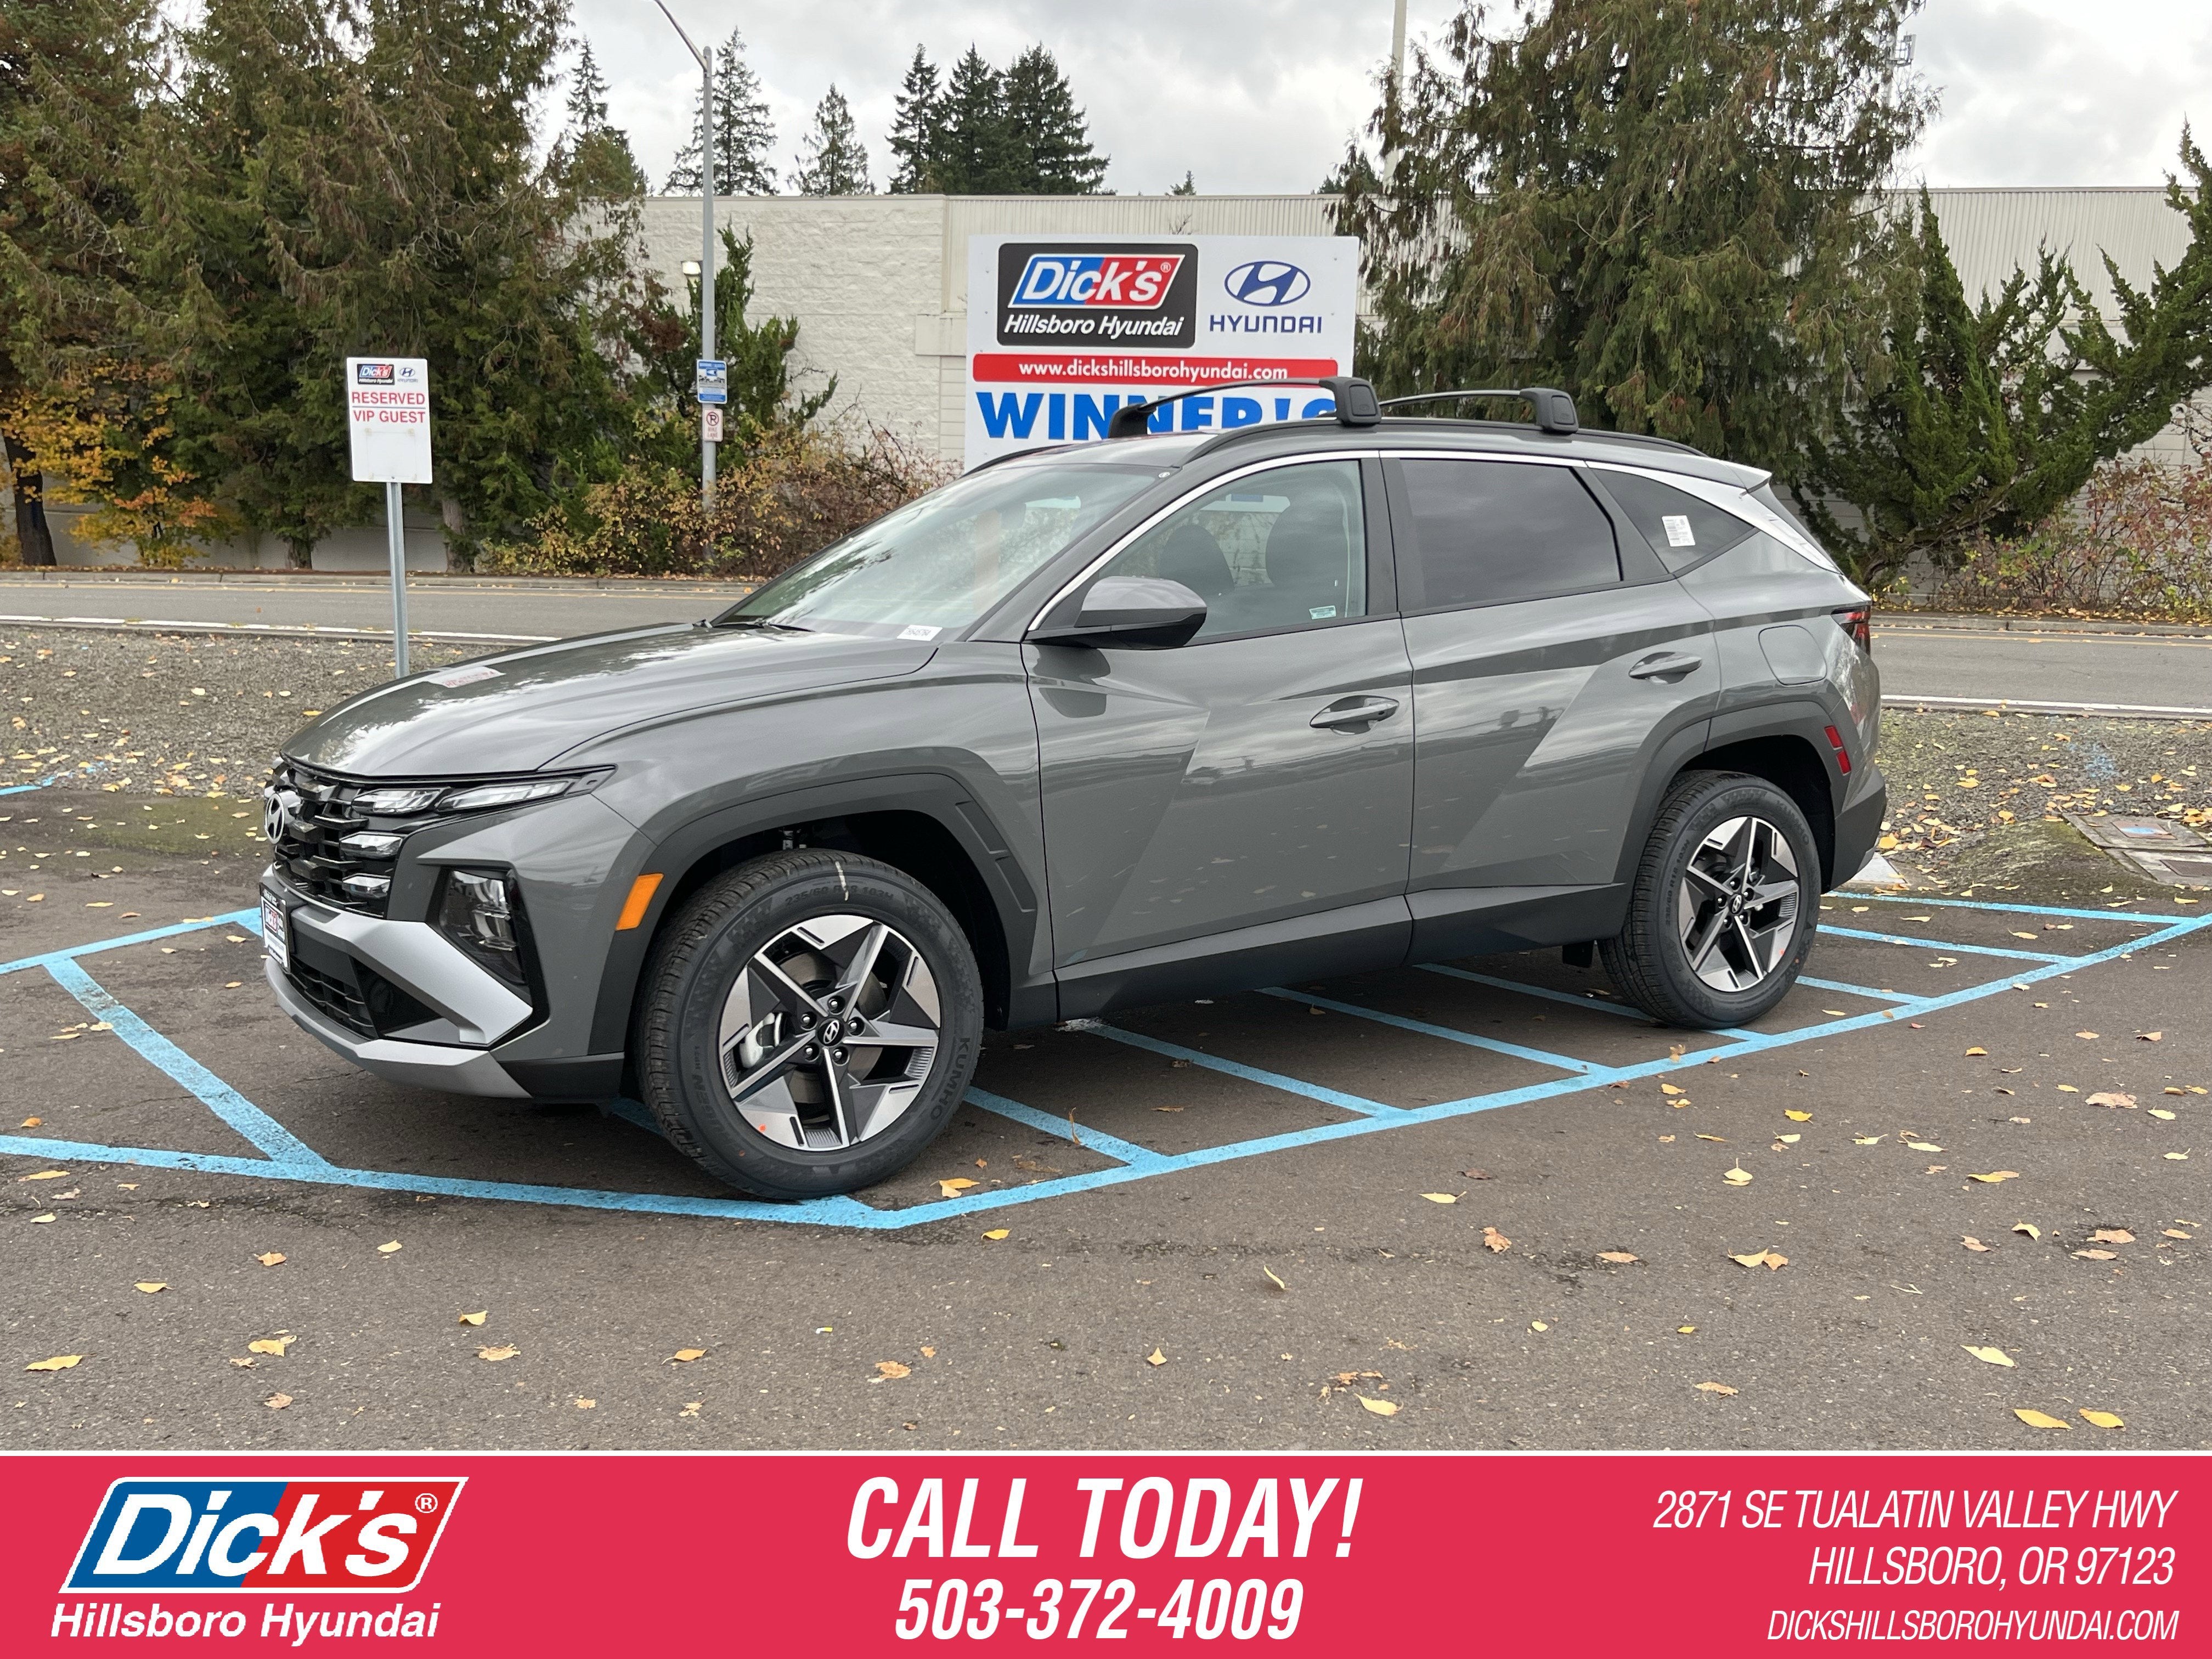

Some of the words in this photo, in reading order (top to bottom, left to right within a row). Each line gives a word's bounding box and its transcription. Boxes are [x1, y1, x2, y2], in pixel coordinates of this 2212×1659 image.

[1004, 314, 1095, 335] Hillsboro
[1098, 315, 1184, 340] Hyundai
[1210, 315, 1322, 334] HYUNDAI
[1019, 358, 1288, 383] www.dickshillsborohyundai.com
[352, 392, 426, 405] RESERVED
[353, 410, 375, 422] VIP
[379, 410, 426, 423] GUEST
[833, 885, 857, 893] R8
[930, 1037, 972, 1120] KUMHO
